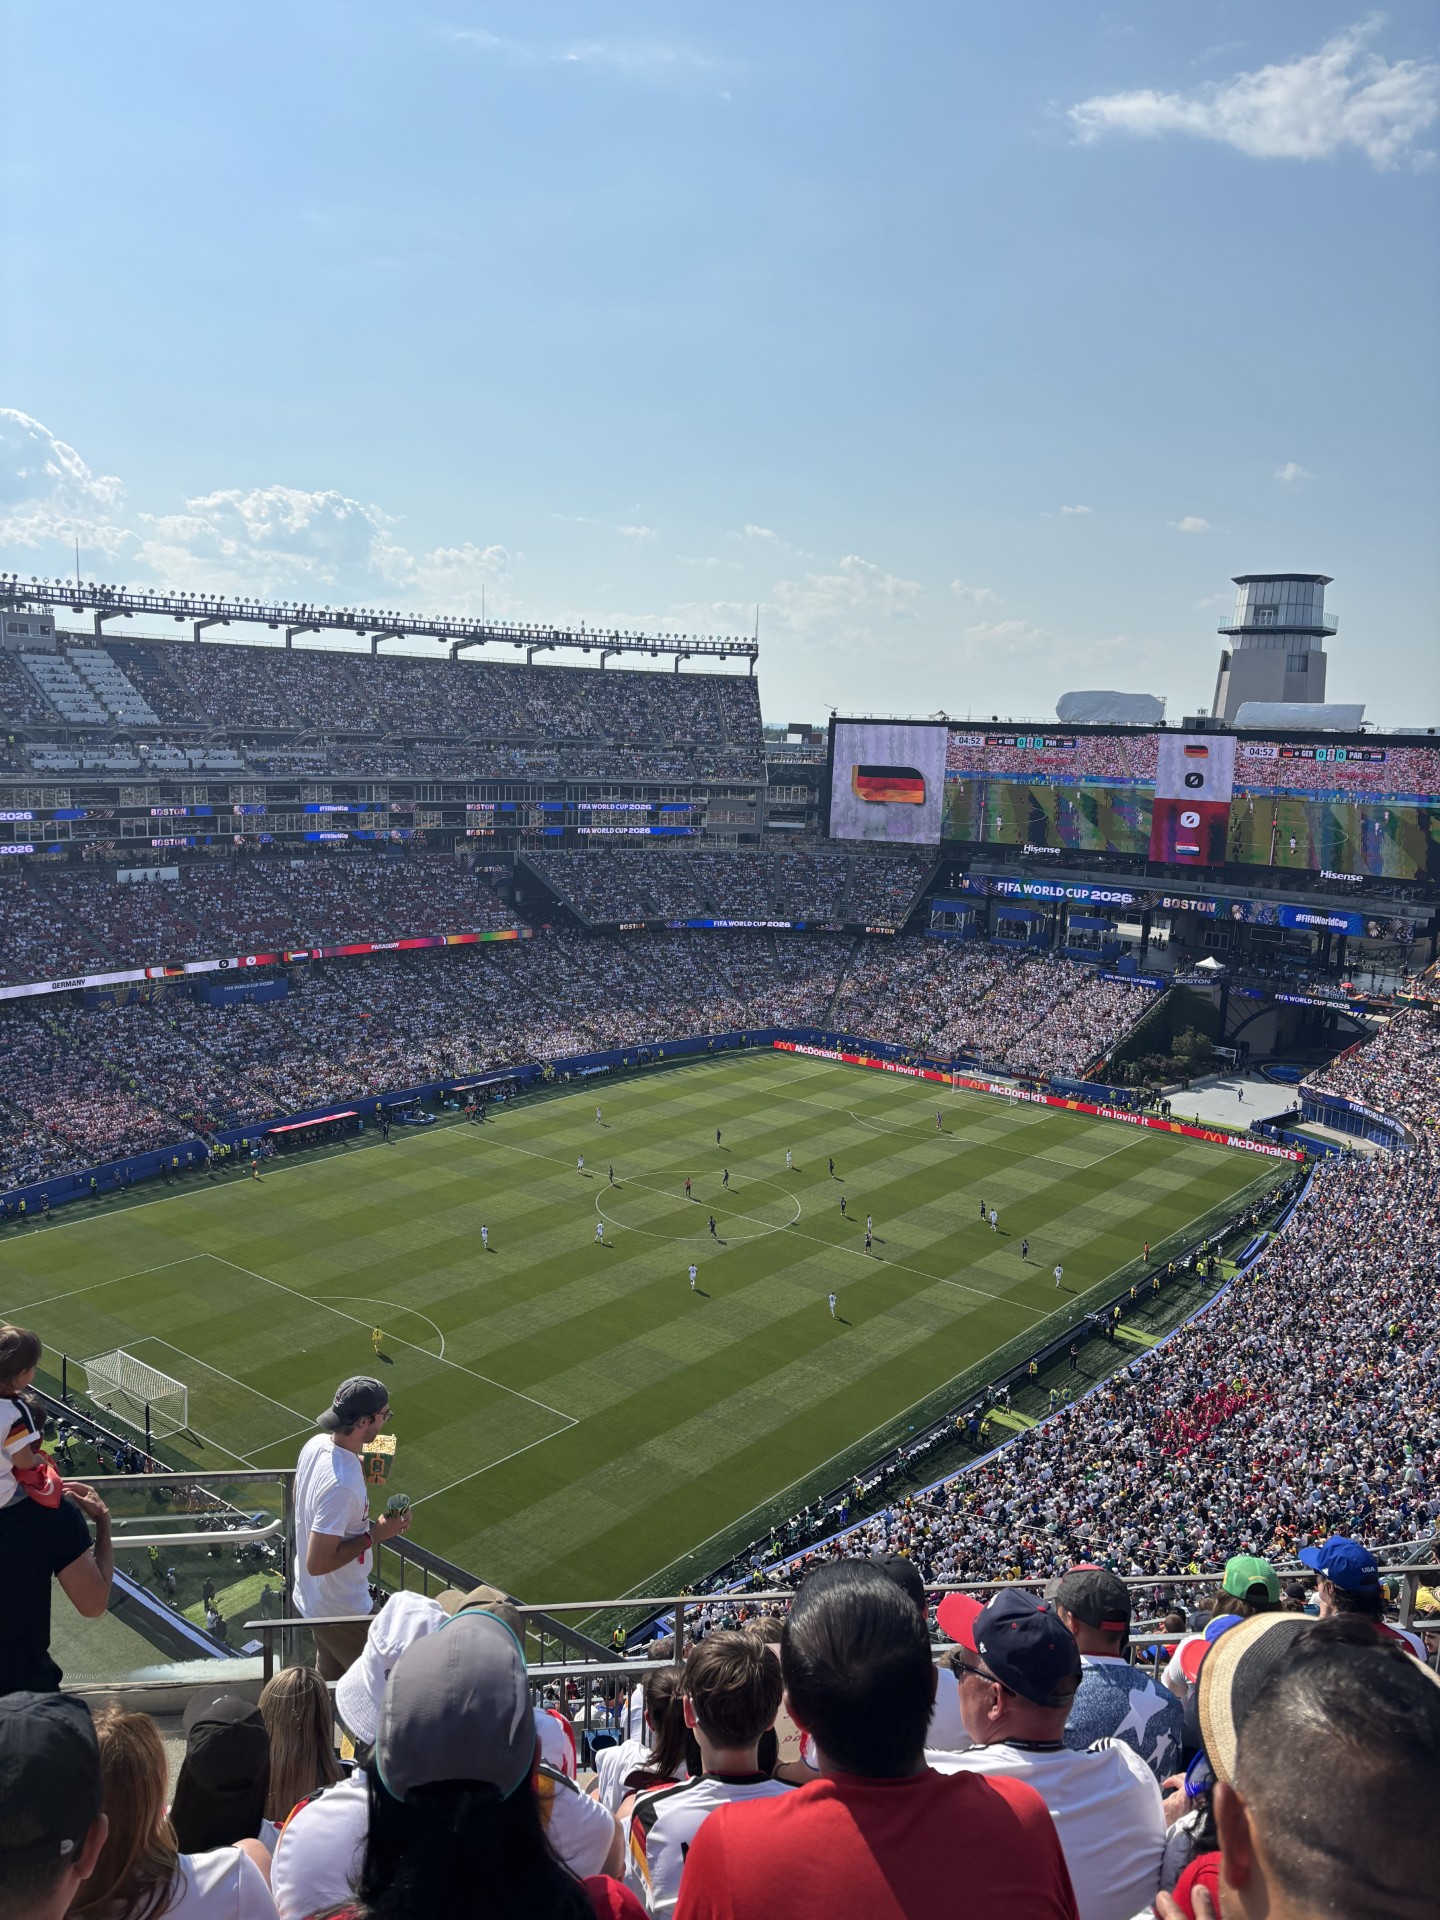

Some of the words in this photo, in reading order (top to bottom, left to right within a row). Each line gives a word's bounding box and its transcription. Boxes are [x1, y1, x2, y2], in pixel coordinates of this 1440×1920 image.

[958, 736, 981, 745] 04:52
[1249, 747, 1274, 757] 04:52
[1301, 749, 1313, 757] GER
[1318, 750, 1324, 758] 0
[1338, 751, 1344, 759] 0
[1349, 751, 1363, 760] PAR
[151, 807, 187, 816] BOSTON
[466, 803, 494, 811] BOSTON
[0, 810, 33, 821] 2026
[151, 838, 187, 847] BOSTON
[1, 844, 34, 854] 2026
[1023, 844, 1061, 854] Hisense
[1320, 869, 1363, 882] Hisense
[998, 882, 1021, 893] FIFA
[1023, 884, 1064, 897] WORLD
[1065, 888, 1089, 899] CUP
[1090, 891, 1133, 904] 2026
[1163, 897, 1216, 913] BOSTON
[1295, 913, 1348, 929] #FIFAWorldCup
[866, 926, 895, 934] BOSTON
[51, 978, 86, 990] GERMANY
[1274, 993, 1289, 1001] FIFA
[1289, 996, 1312, 1004] WORLD
[1326, 1001, 1350, 1009] 2026
[795, 1043, 844, 1061] McDonald's
[882, 1061, 895, 1071] i'm
[895, 1064, 918, 1076] lovin'
[918, 1068, 925, 1078] it
[989, 1083, 1048, 1104] McDonald's
[1097, 1106, 1112, 1117] i'm
[1113, 1110, 1141, 1124] lovin'
[1141, 1117, 1149, 1127] it
[1349, 1102, 1364, 1113] FIFA
[1364, 1108, 1383, 1122] WORLD
[1383, 1117, 1395, 1128] CUP
[1227, 1136, 1298, 1161] McDonald's
[1361, 1566, 1376, 1574] USA
